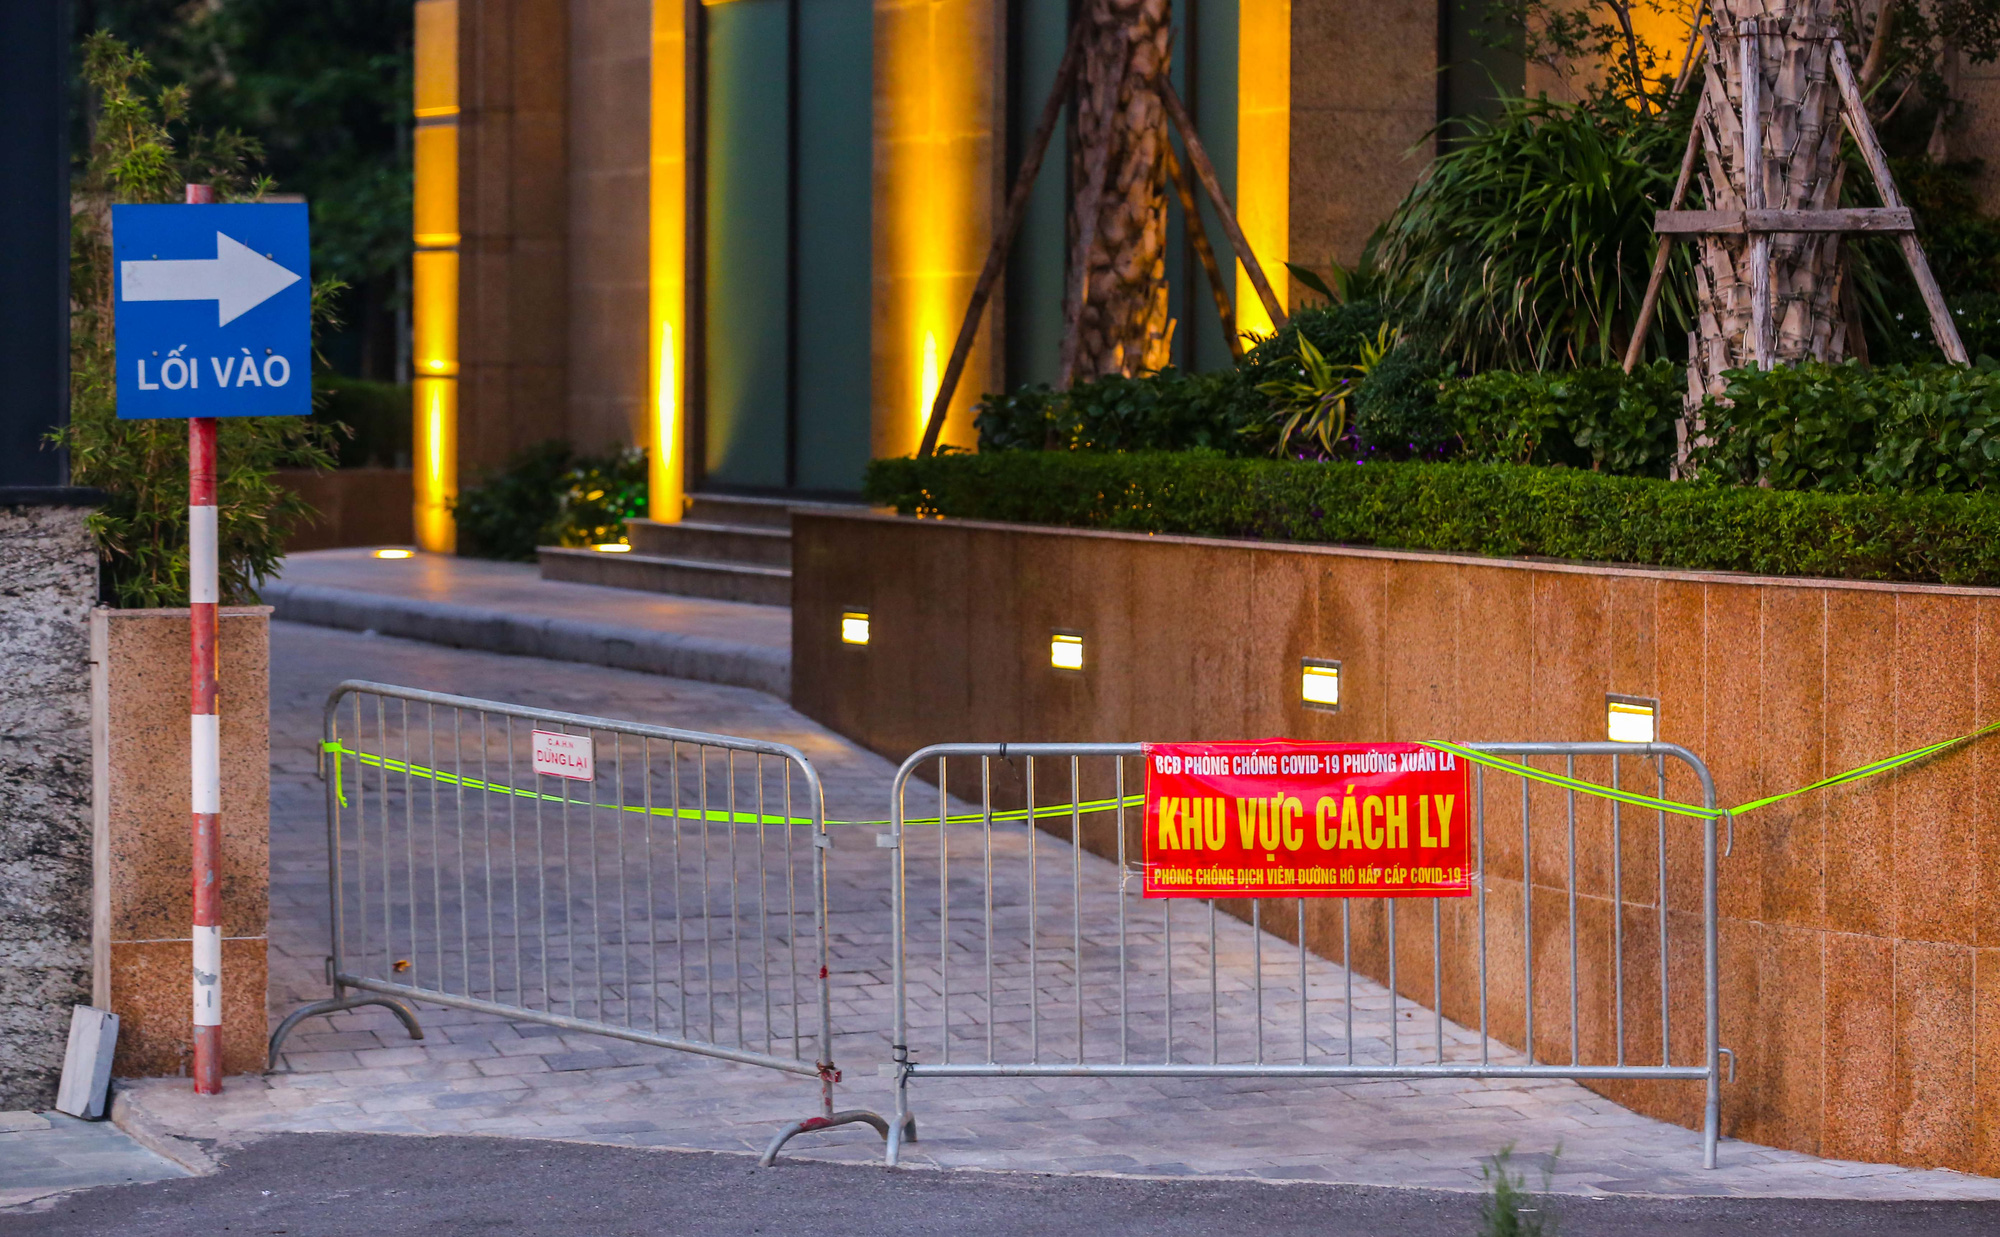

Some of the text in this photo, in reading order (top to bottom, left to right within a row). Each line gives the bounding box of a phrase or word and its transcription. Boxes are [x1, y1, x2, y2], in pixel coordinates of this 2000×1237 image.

[137, 344, 291, 390] LỐI VÀO
[1184, 751, 1229, 775] PHÒNG
[1232, 749, 1278, 775] CHỐNG
[1280, 754, 1340, 775] COVID-19
[1343, 749, 1397, 773] PHƯỜNG
[1400, 748, 1436, 772] XUÂN
[1158, 784, 1456, 862] KHU VỰC CÁCH LY
[1154, 862, 1462, 888] PHÒNG CHỐNG DỊCH VIÊM ĐƯỜNG HÔ HẤP CẤP COVID-19
